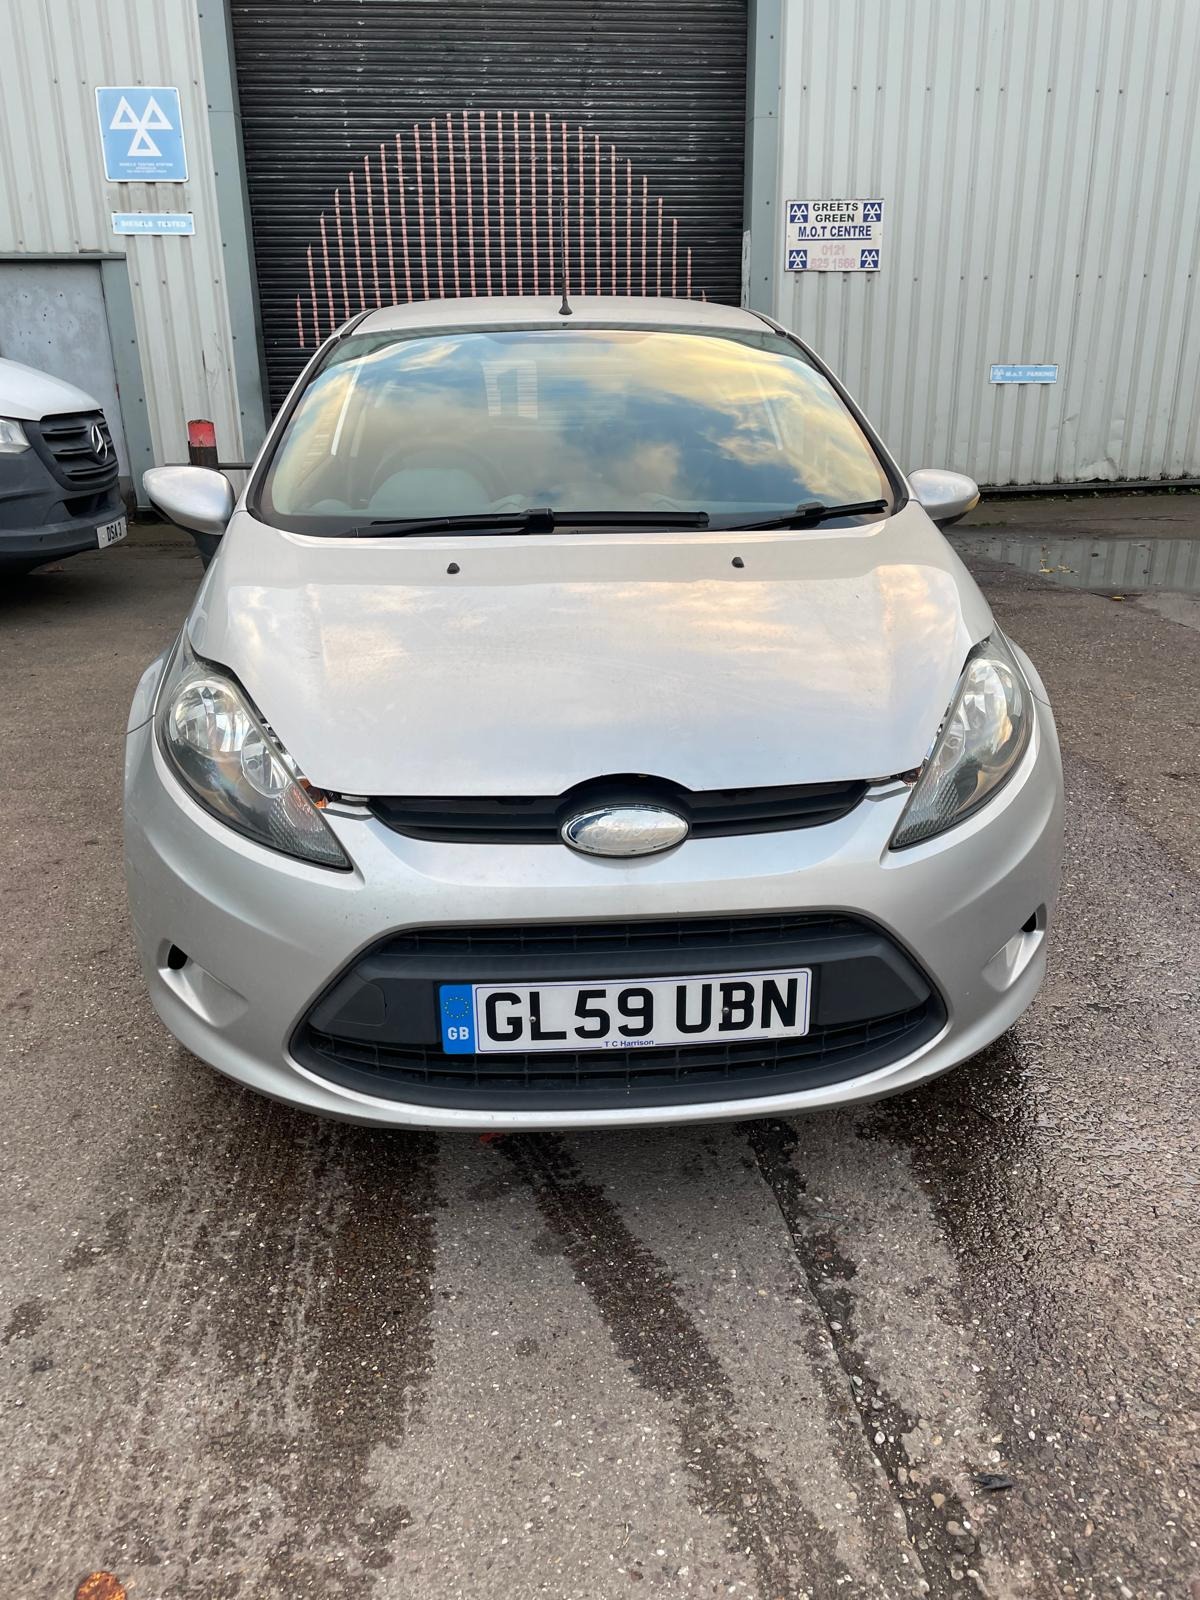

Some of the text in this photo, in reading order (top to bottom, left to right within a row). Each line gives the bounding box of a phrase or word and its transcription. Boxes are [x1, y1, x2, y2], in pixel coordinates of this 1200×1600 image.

[812, 202, 859, 212] GREETS
[815, 213, 855, 223] GREEN
[798, 225, 872, 238] M.O.T CENTRE
[821, 244, 846, 256] 0121
[485, 978, 798, 1042] GL59 UBN
[447, 1026, 470, 1041] GB
[620, 1039, 654, 1047] Harrison
